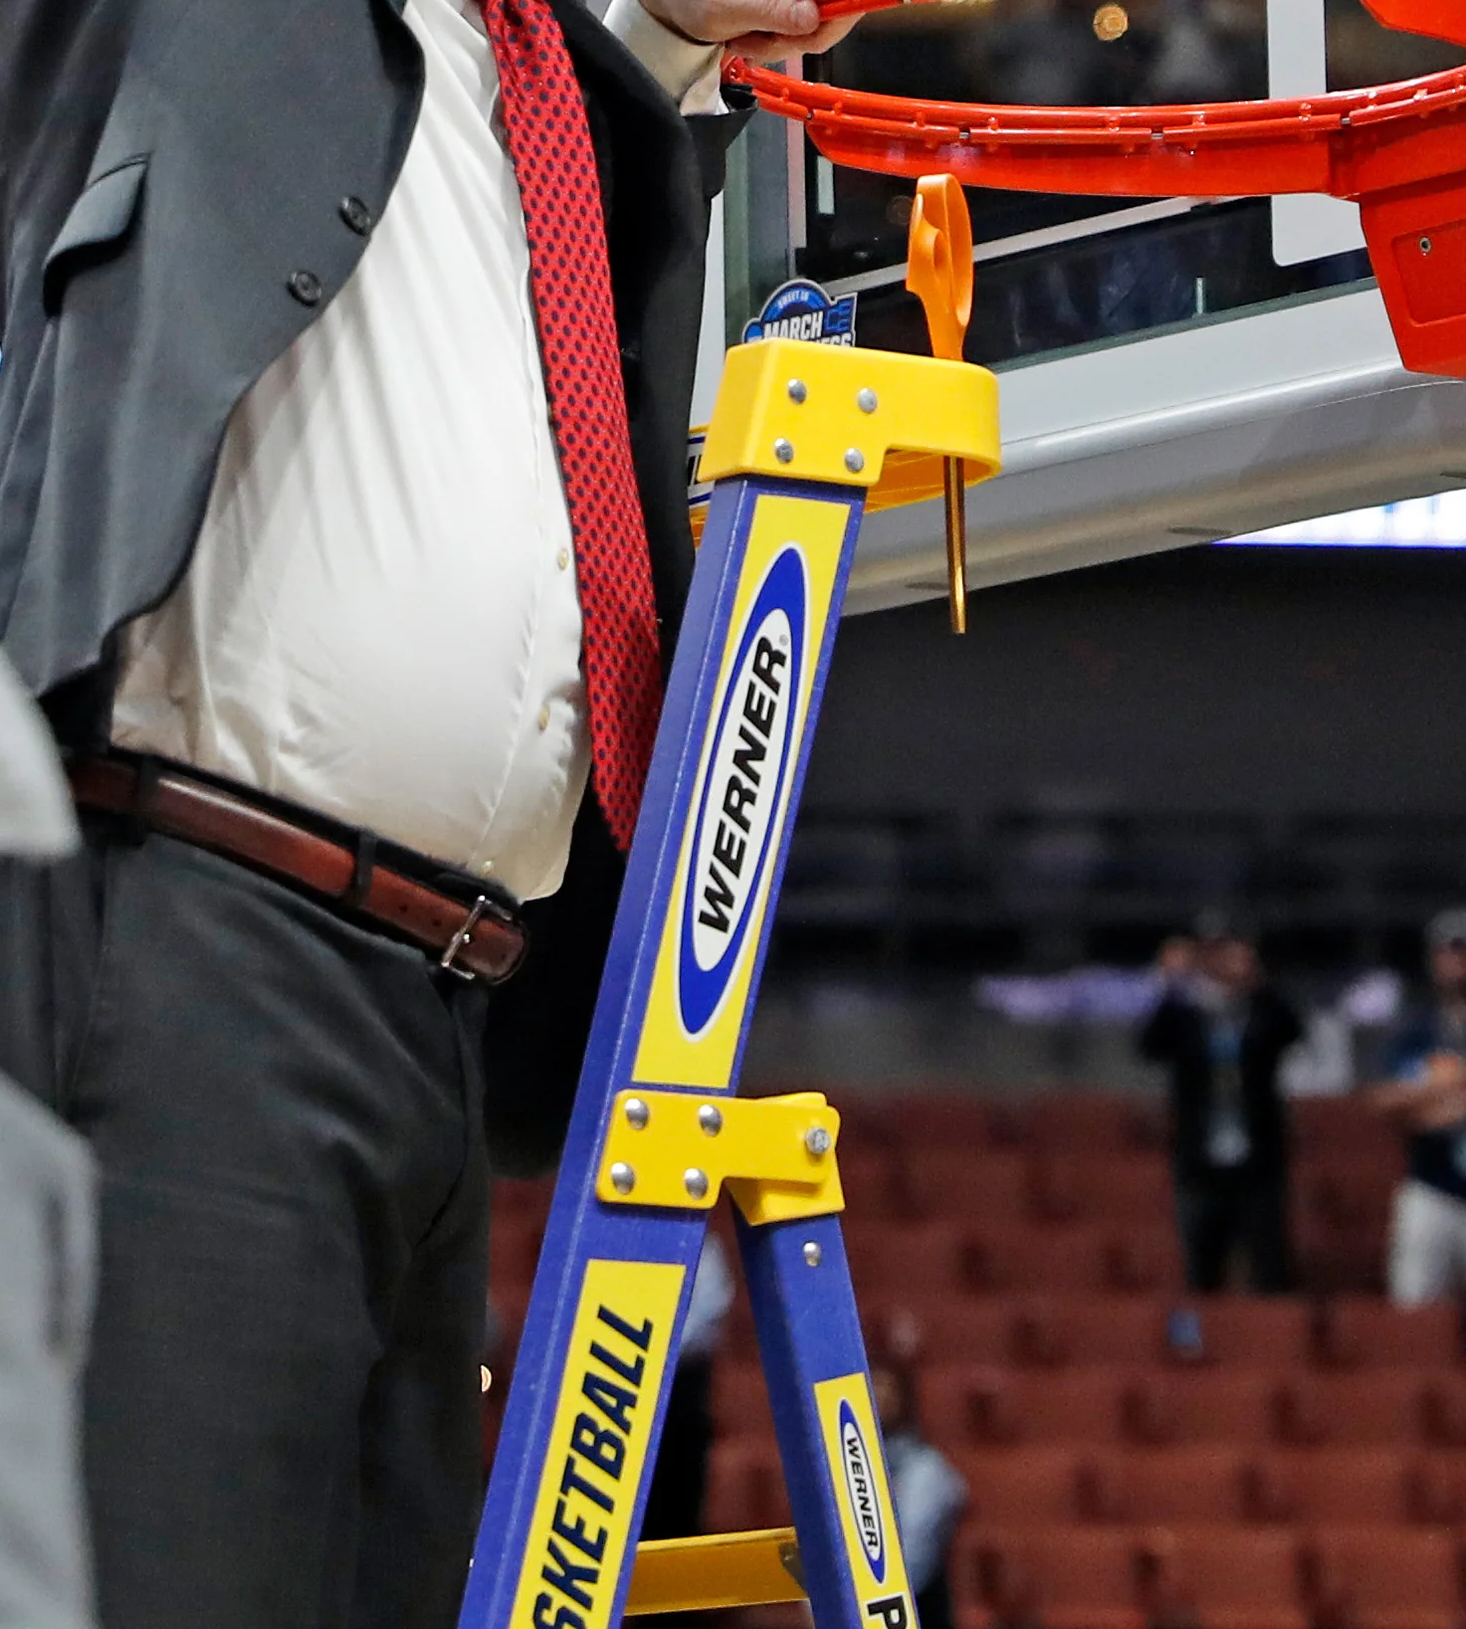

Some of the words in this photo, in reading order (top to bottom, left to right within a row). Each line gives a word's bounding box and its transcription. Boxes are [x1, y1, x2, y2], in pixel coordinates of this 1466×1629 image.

[764, 311, 824, 342] MARCH
[698, 634, 787, 934] WERNER
[846, 1436, 879, 1550] WERNER
